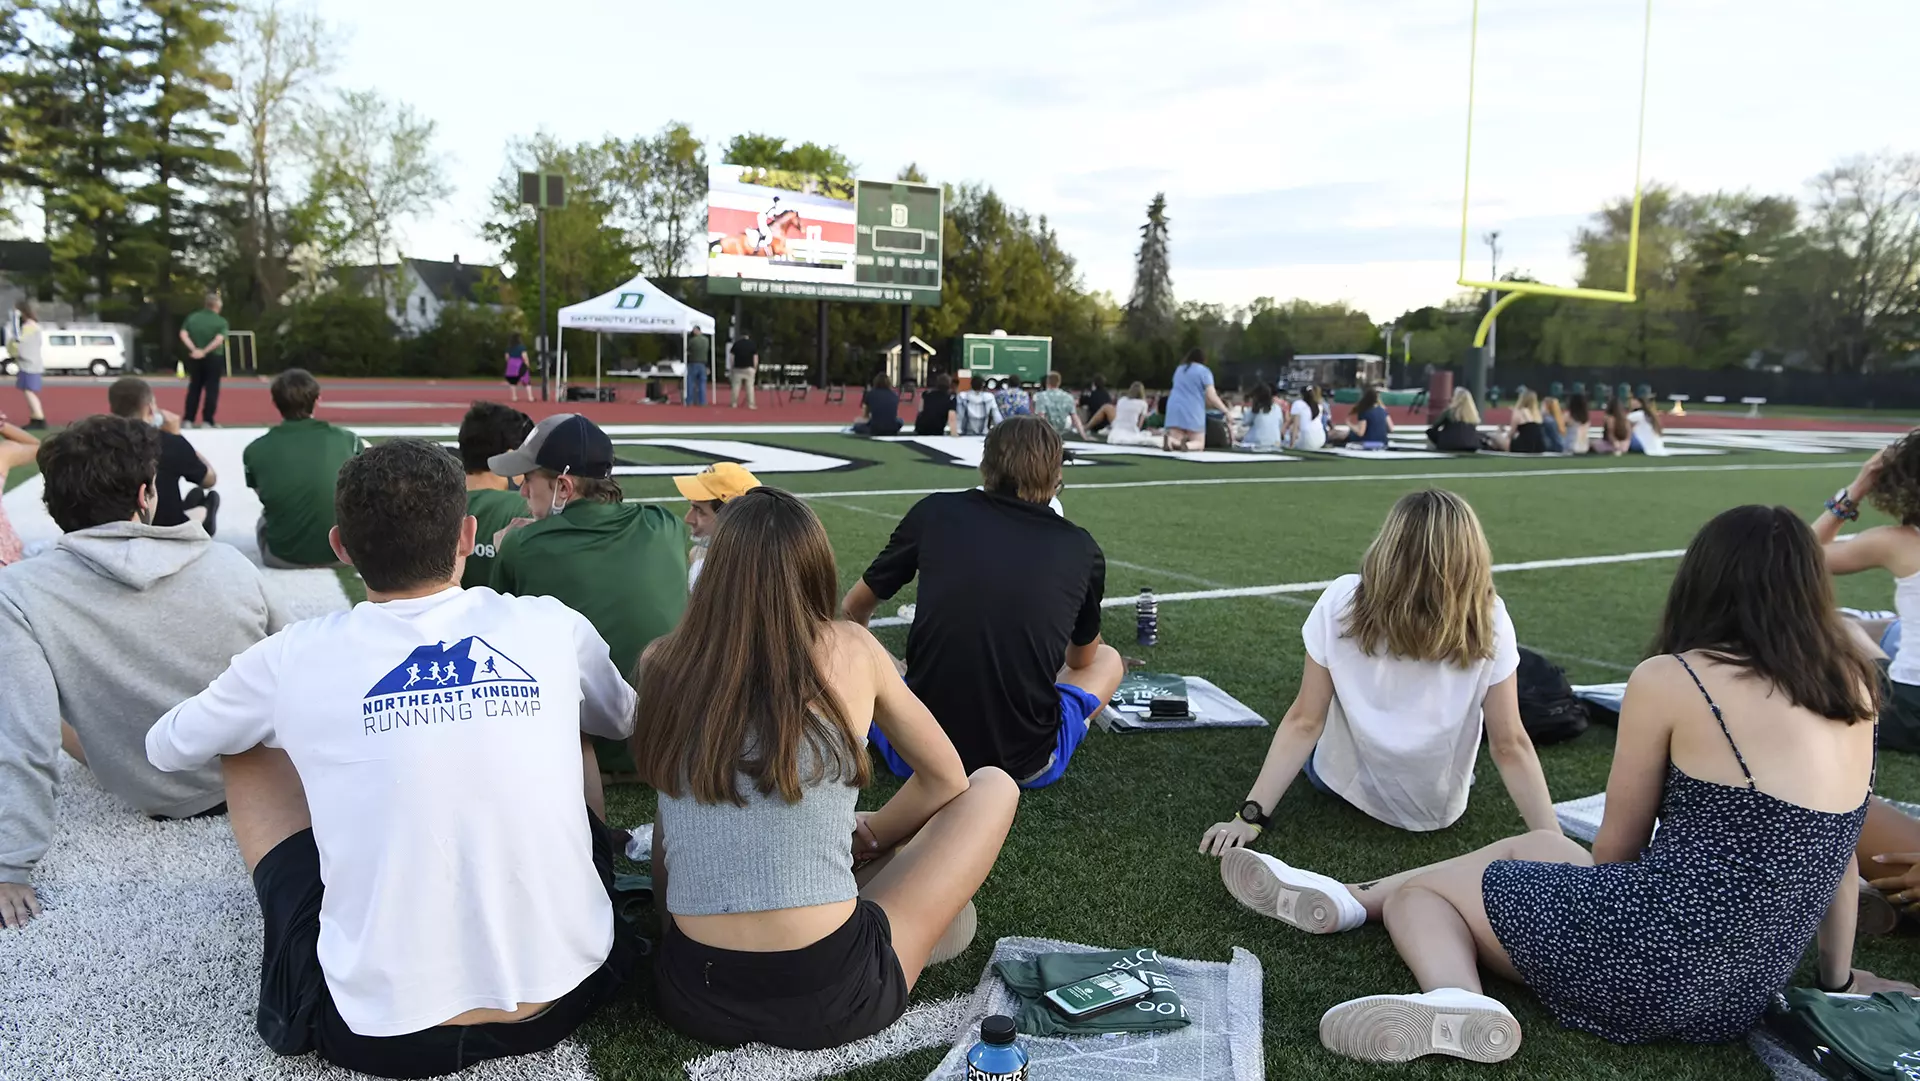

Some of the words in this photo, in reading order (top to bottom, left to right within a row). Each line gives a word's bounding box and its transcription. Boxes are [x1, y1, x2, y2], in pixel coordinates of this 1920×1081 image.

[758, 282, 769, 293] OF
[615, 293, 645, 309] D
[570, 315, 626, 324] DARTMOUTH
[628, 315, 676, 325] ATHLETICS
[471, 543, 495, 558] 08
[363, 690, 464, 715] NORTHEAST
[471, 685, 540, 700] KINGDOM
[364, 703, 473, 736] RUNNING
[485, 700, 541, 717] CAMP
